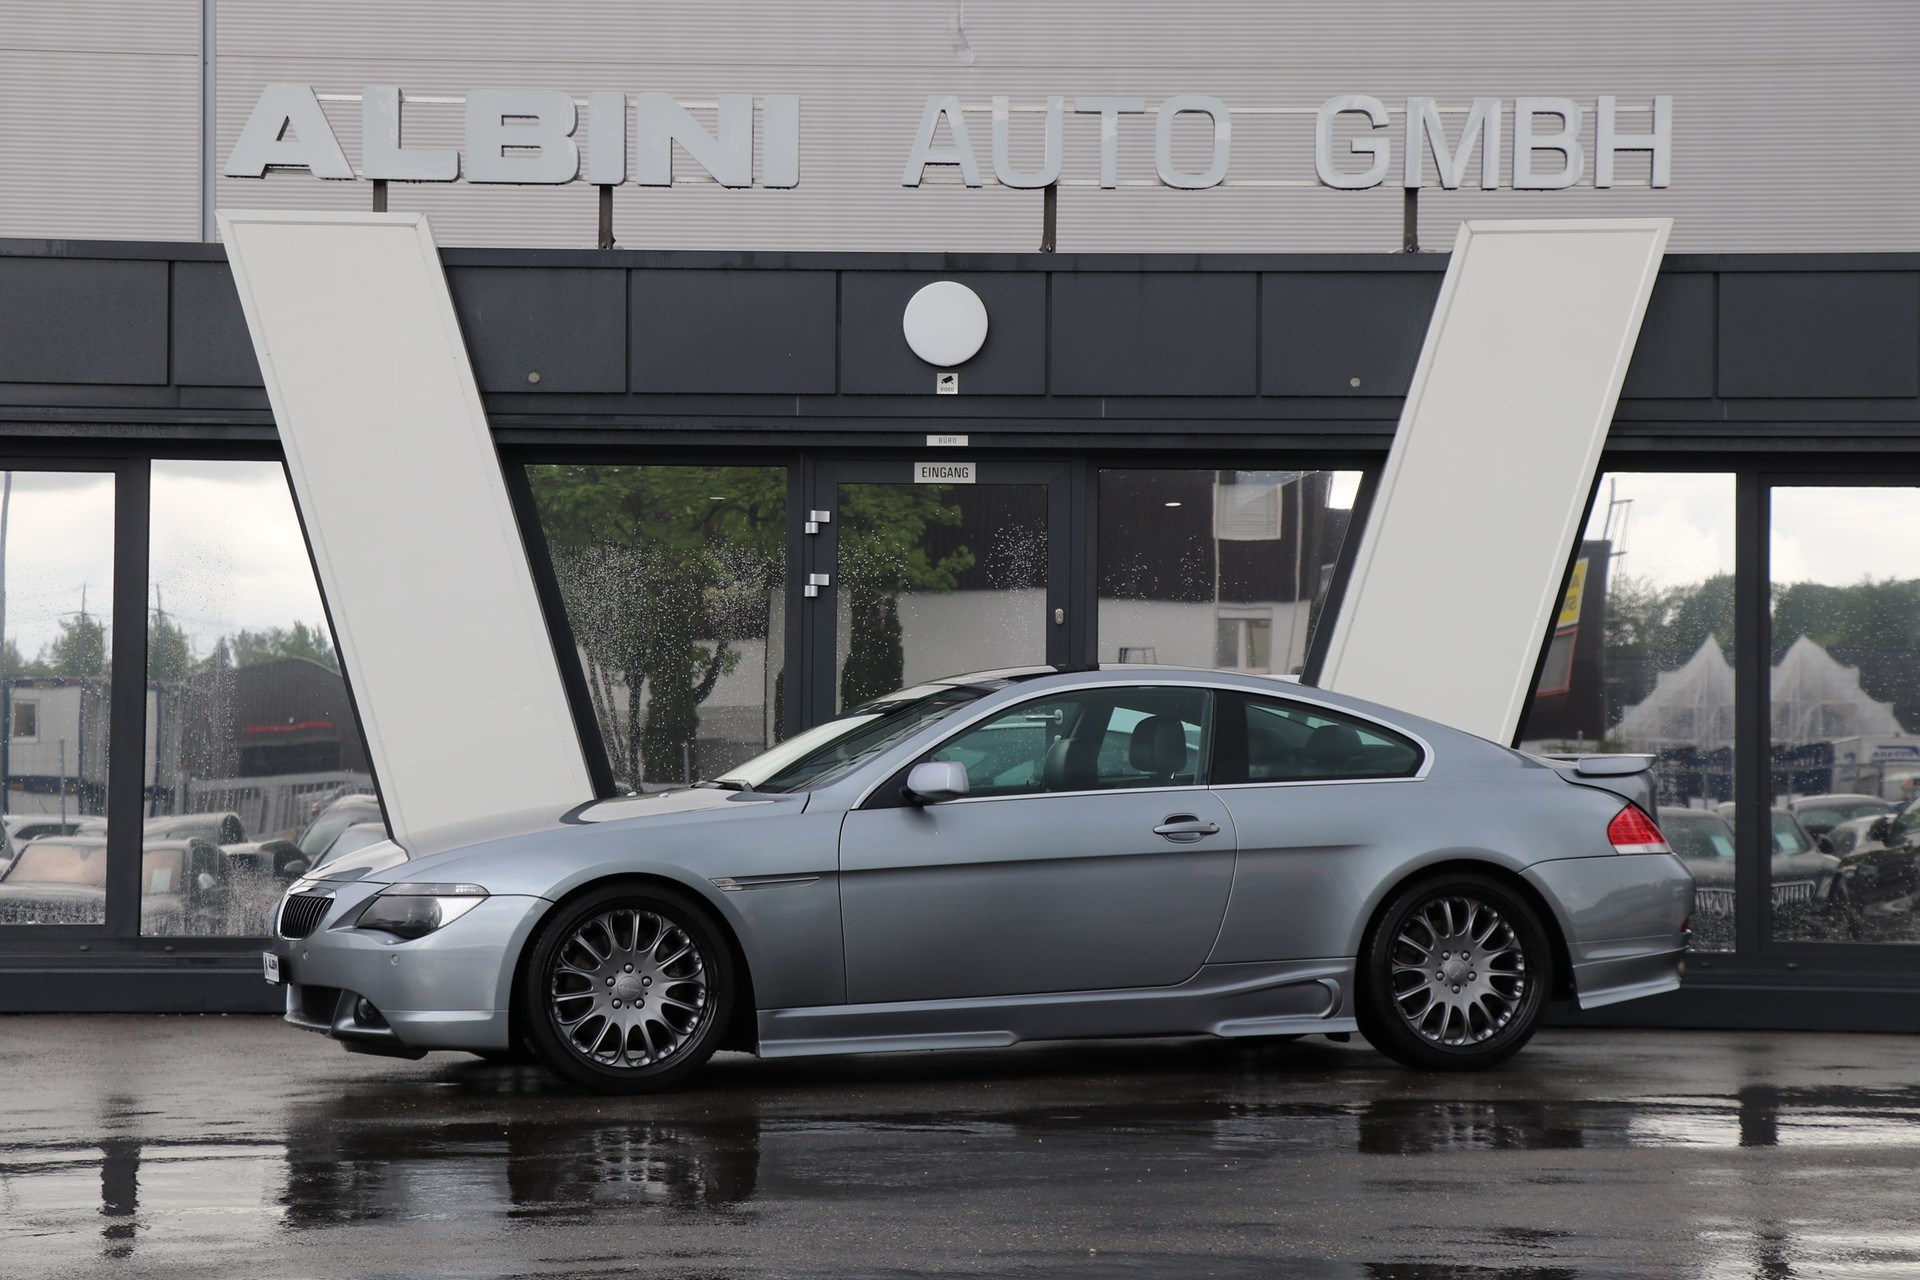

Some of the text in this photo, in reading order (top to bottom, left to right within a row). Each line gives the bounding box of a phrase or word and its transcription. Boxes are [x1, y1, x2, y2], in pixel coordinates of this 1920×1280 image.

[223, 83, 1673, 190] ALBINI AUTO GMBH
[921, 466, 969, 478] EINGANG
